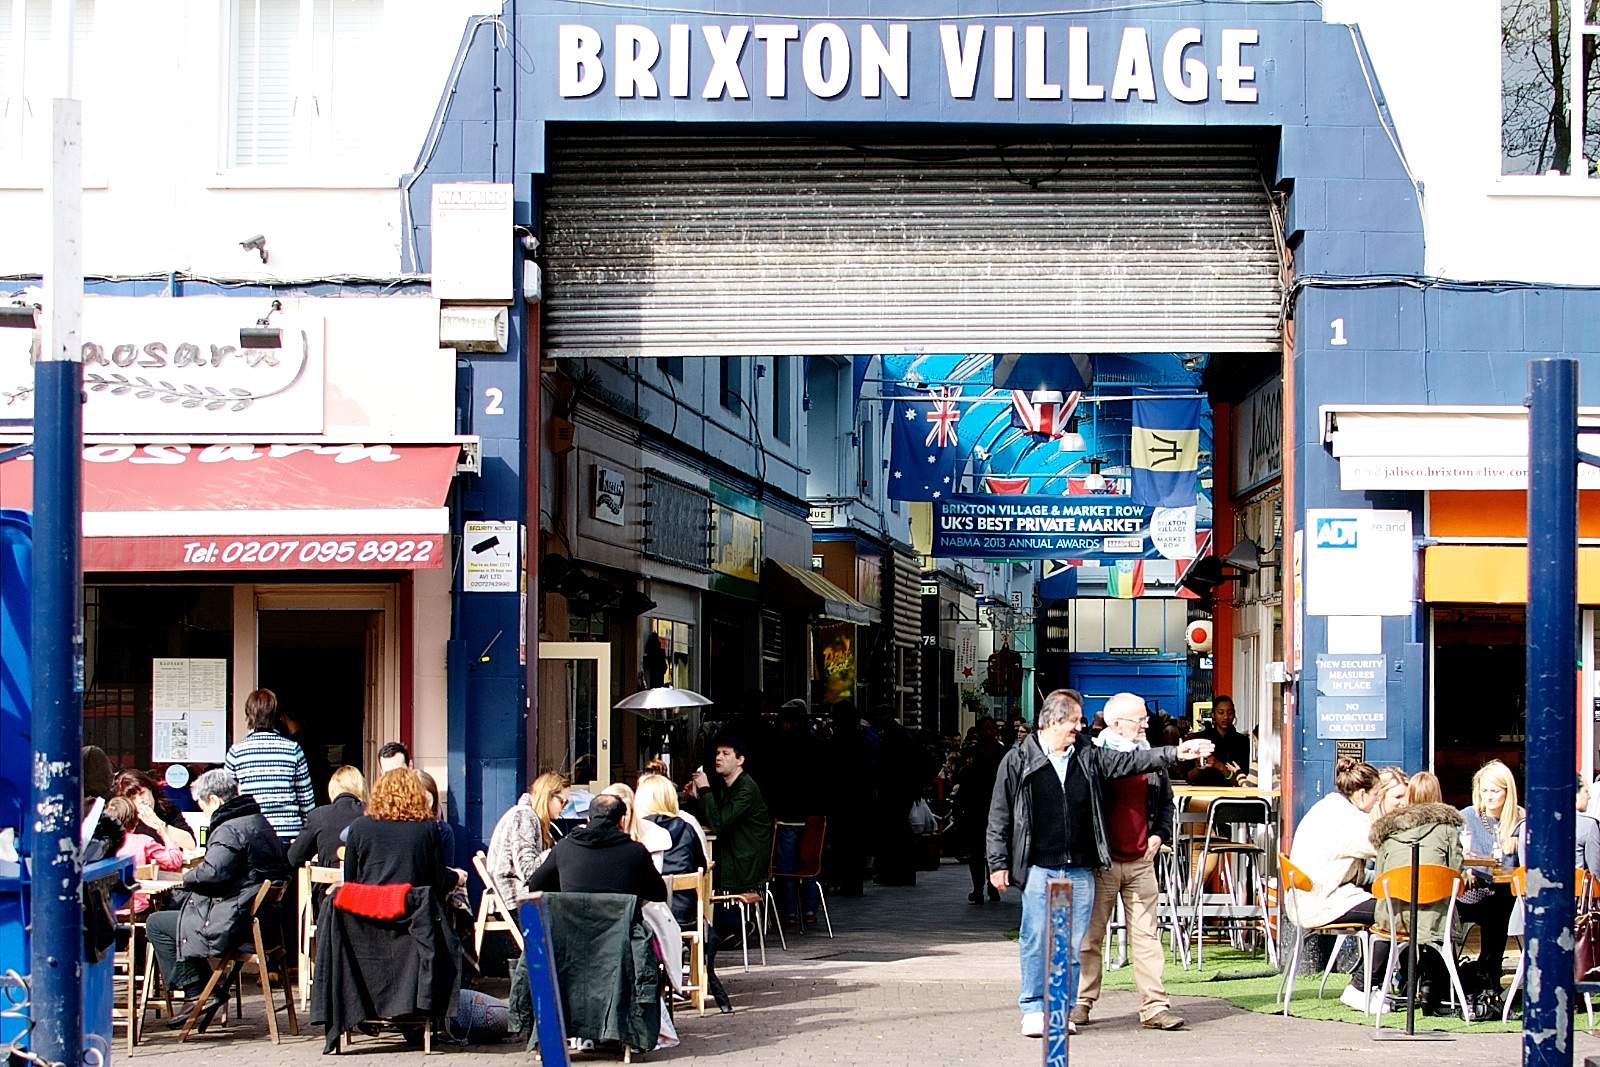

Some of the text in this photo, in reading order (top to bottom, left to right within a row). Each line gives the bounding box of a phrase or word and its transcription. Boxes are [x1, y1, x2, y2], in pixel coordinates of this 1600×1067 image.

[559, 23, 1259, 104] BRIXTON VILLAGE
[1330, 318, 1348, 346] 1
[29, 341, 280, 368] aosarn
[485, 387, 504, 415] 2
[942, 504, 1145, 517] BRIXTON VILLAGE & MARKET ROW
[941, 516, 1144, 532] UK'S BEST PRIVATE MARKET
[1317, 521, 1358, 546] ADT
[940, 537, 981, 548] NABMA
[983, 538, 1006, 548] 2013
[1008, 538, 1054, 549] ANNUAL
[1055, 539, 1100, 550] AWARDS
[183, 540, 434, 563] Tel: 0207 095 8922
[1320, 660, 1383, 669] NEW SECURITY
[1329, 671, 1375, 679] MEASURES
[1332, 681, 1372, 689] IN PLACE
[1344, 703, 1360, 711] NO
[1320, 713, 1384, 722] MOTORCYCLES
[1329, 723, 1376, 732] OR CYCLES
